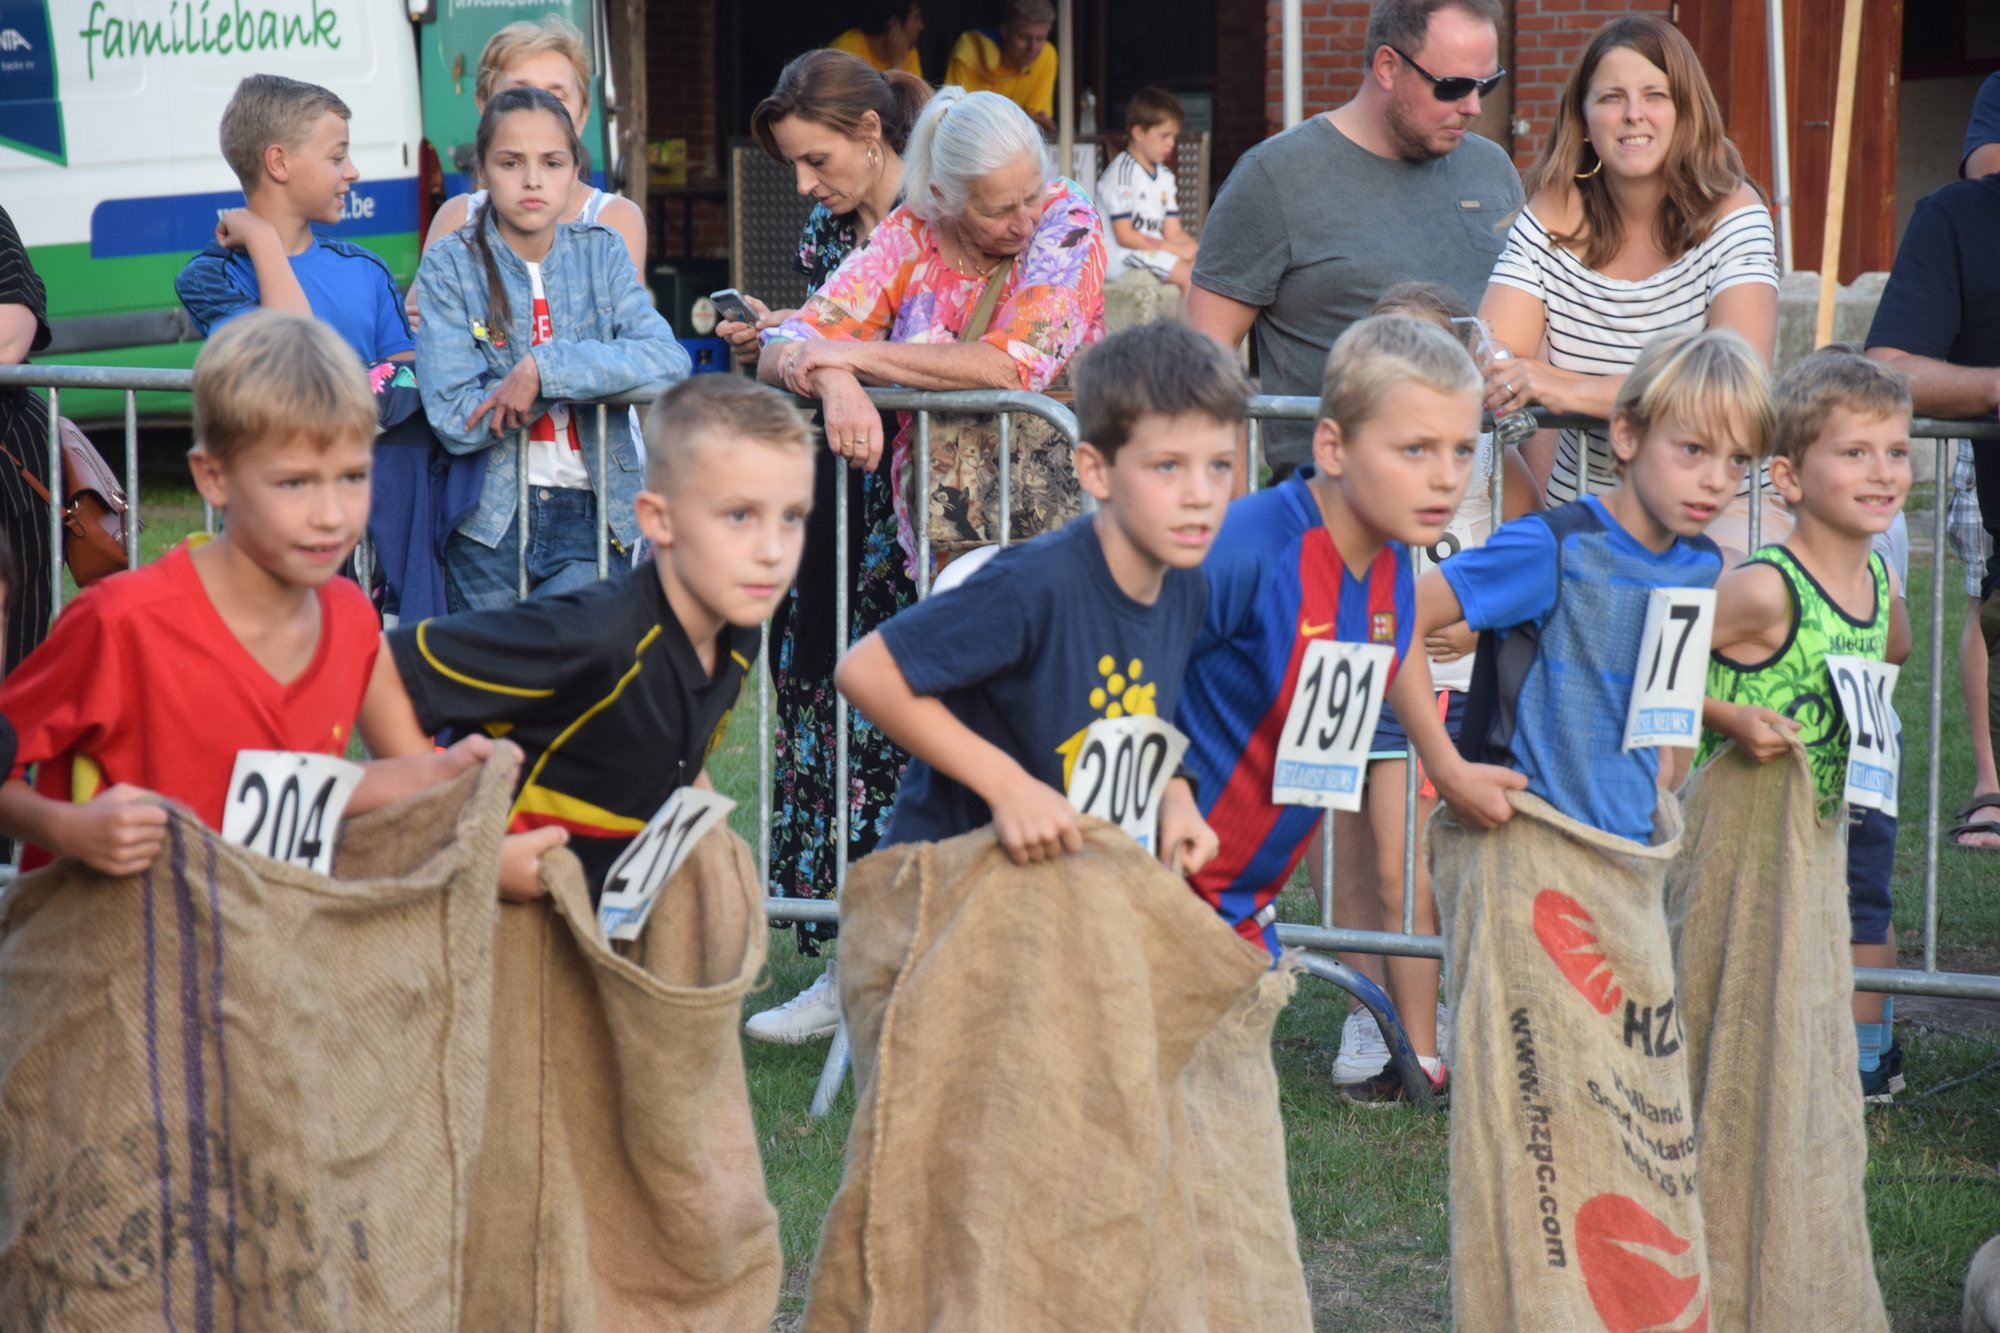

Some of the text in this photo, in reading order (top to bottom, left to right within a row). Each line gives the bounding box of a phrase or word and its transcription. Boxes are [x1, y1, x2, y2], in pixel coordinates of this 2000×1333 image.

[79, 0, 341, 80] familiebank
[1295, 656, 1374, 751] 191
[238, 771, 338, 869] 204
[1080, 732, 1168, 825] 200
[1510, 1007, 1567, 1269] www.hzpc.com
